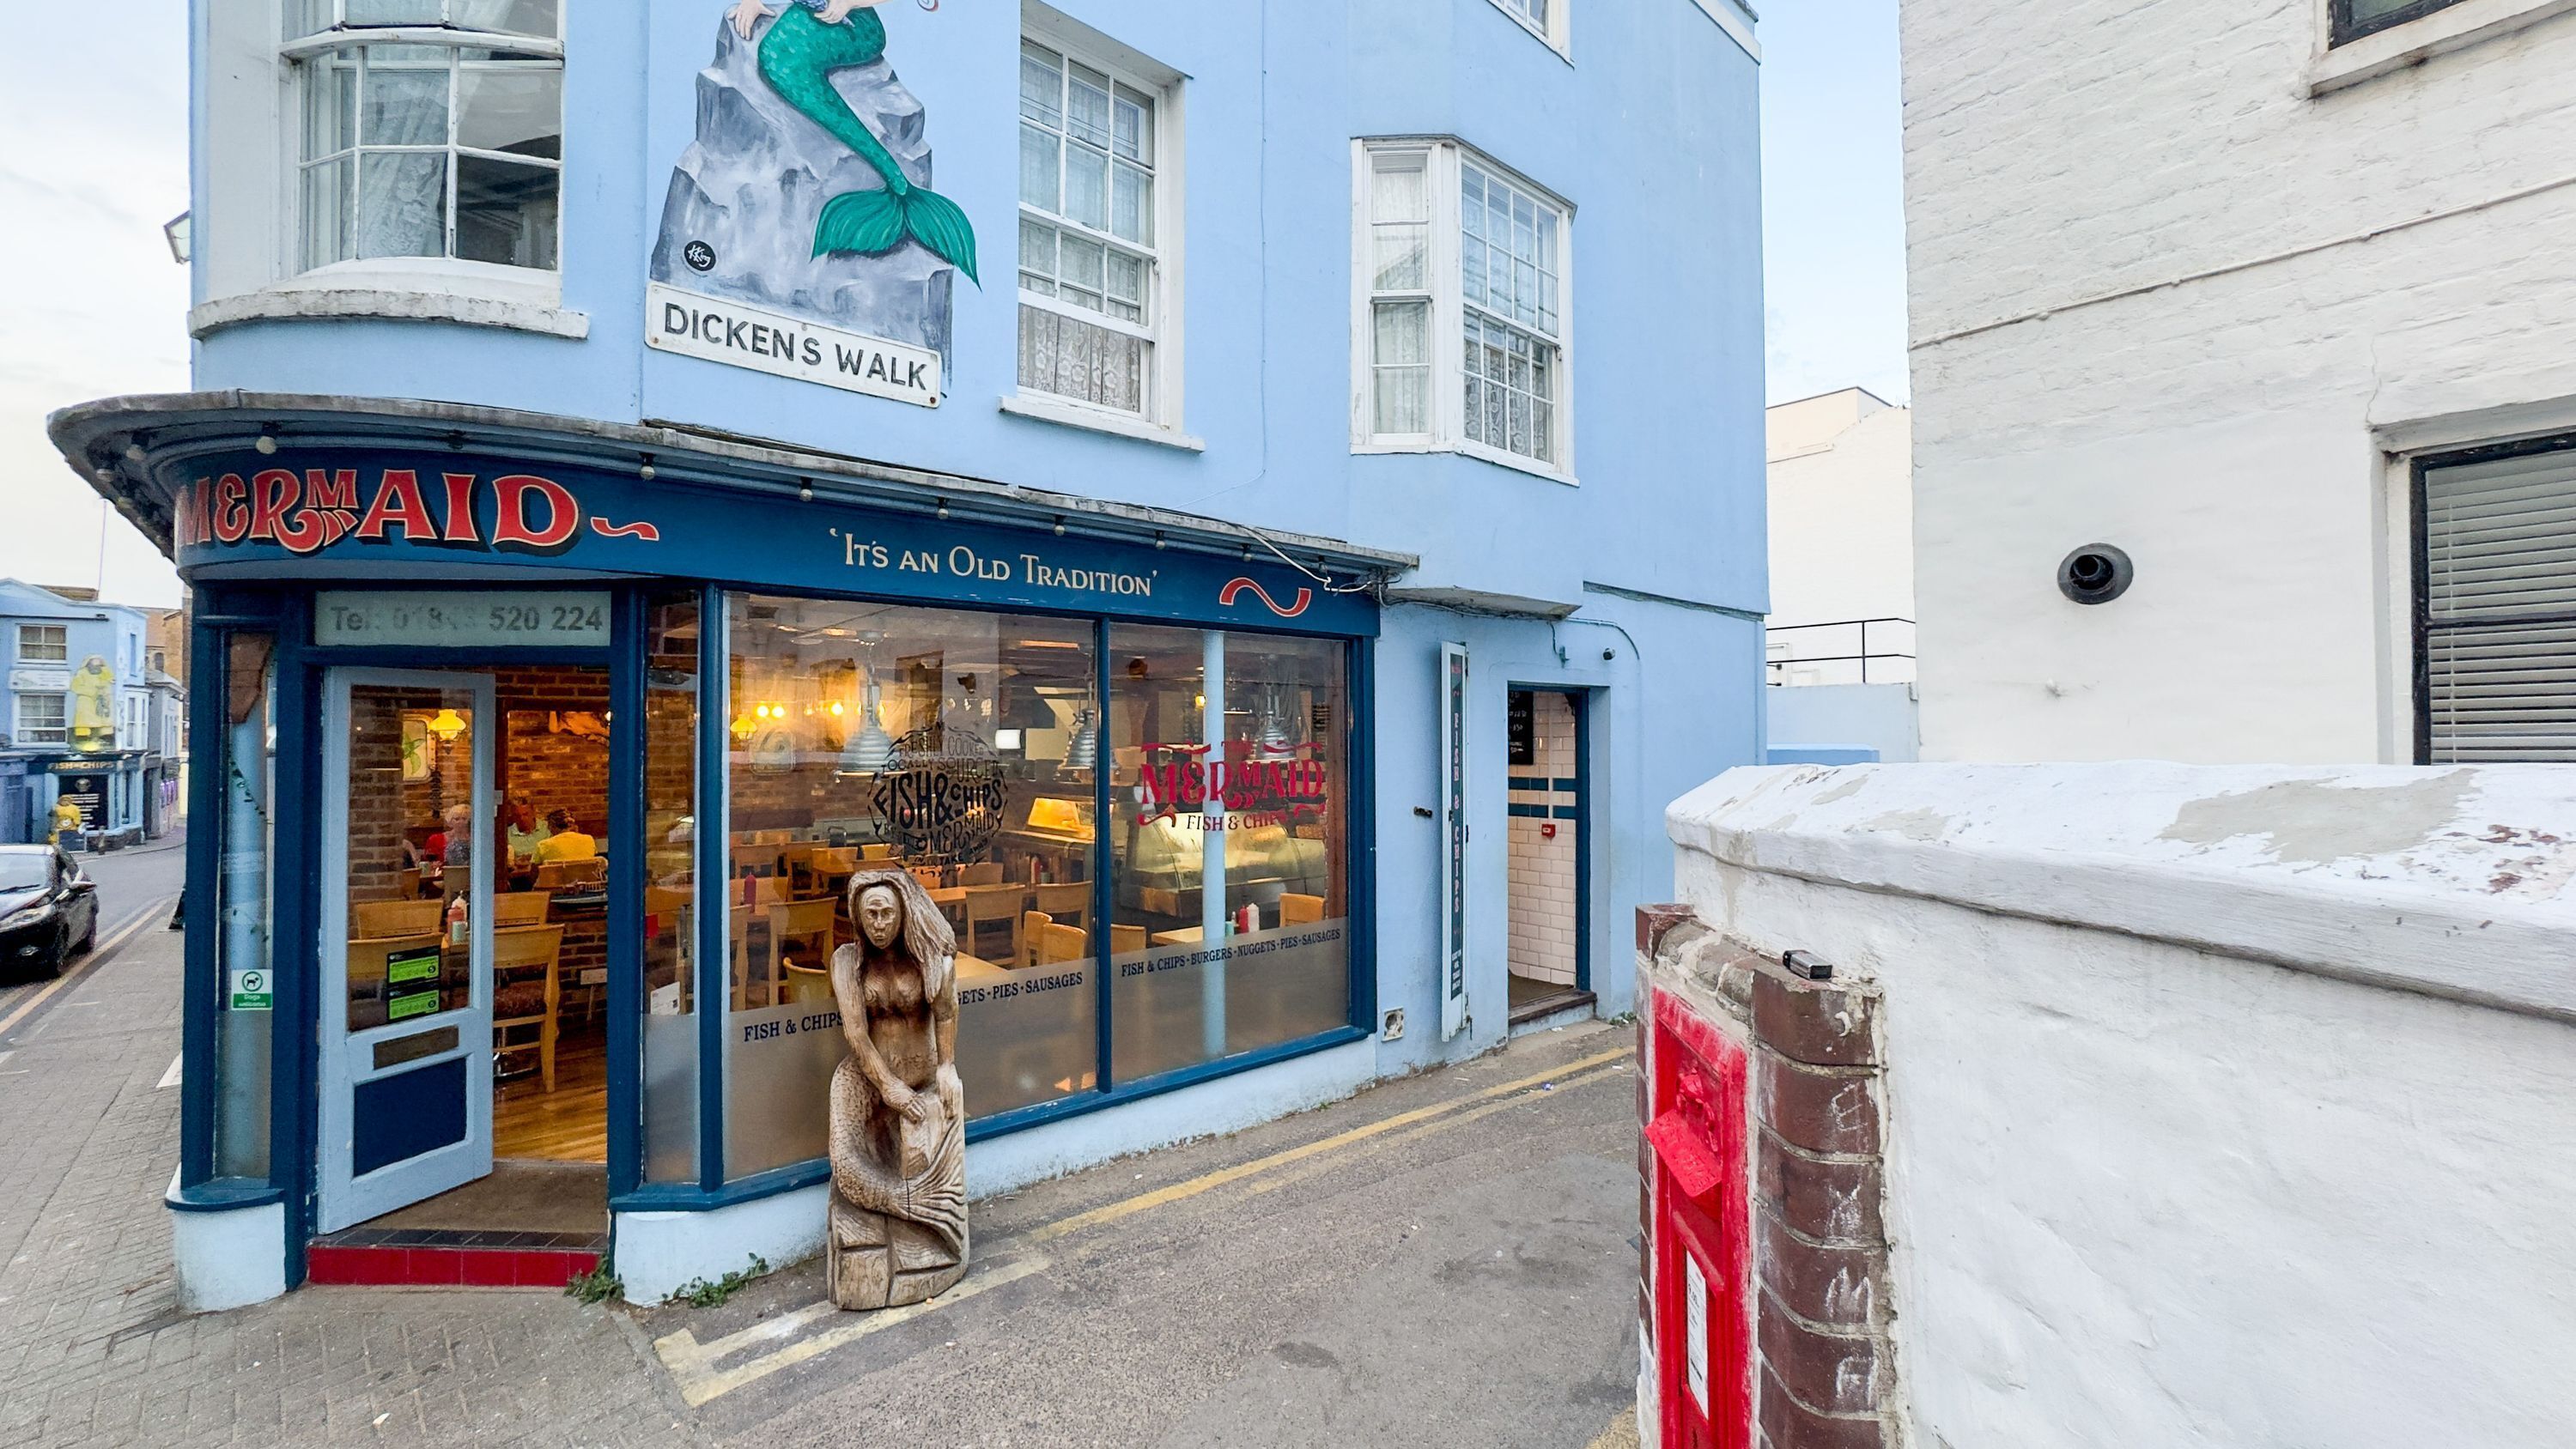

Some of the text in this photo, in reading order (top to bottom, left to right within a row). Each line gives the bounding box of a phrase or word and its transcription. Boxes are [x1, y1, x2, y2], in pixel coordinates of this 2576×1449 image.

[665, 302, 927, 391] DICKENS WALK
[174, 469, 580, 553] MERMAID
[899, 550, 939, 574] AN
[949, 546, 1011, 582] OLD
[489, 606, 540, 631] 520
[551, 606, 603, 631] 224
[899, 735, 984, 759] FRESHLY COOKED
[881, 757, 999, 783] LOCALLY SOURCED
[1141, 760, 1323, 809] MERMAID
[951, 779, 1002, 812] CHIPS
[930, 811, 994, 854] MERMAID
[1188, 815, 1223, 831] FISH
[1228, 815, 1240, 830] &
[1121, 928, 1341, 977] FISH & CHIPS BURGERS NUGGETS PIES SAUSAGES
[993, 982, 1018, 999] PIES
[1025, 972, 1083, 994] SAUSAGES
[744, 1022, 780, 1042] FISH
[786, 1019, 797, 1034] &
